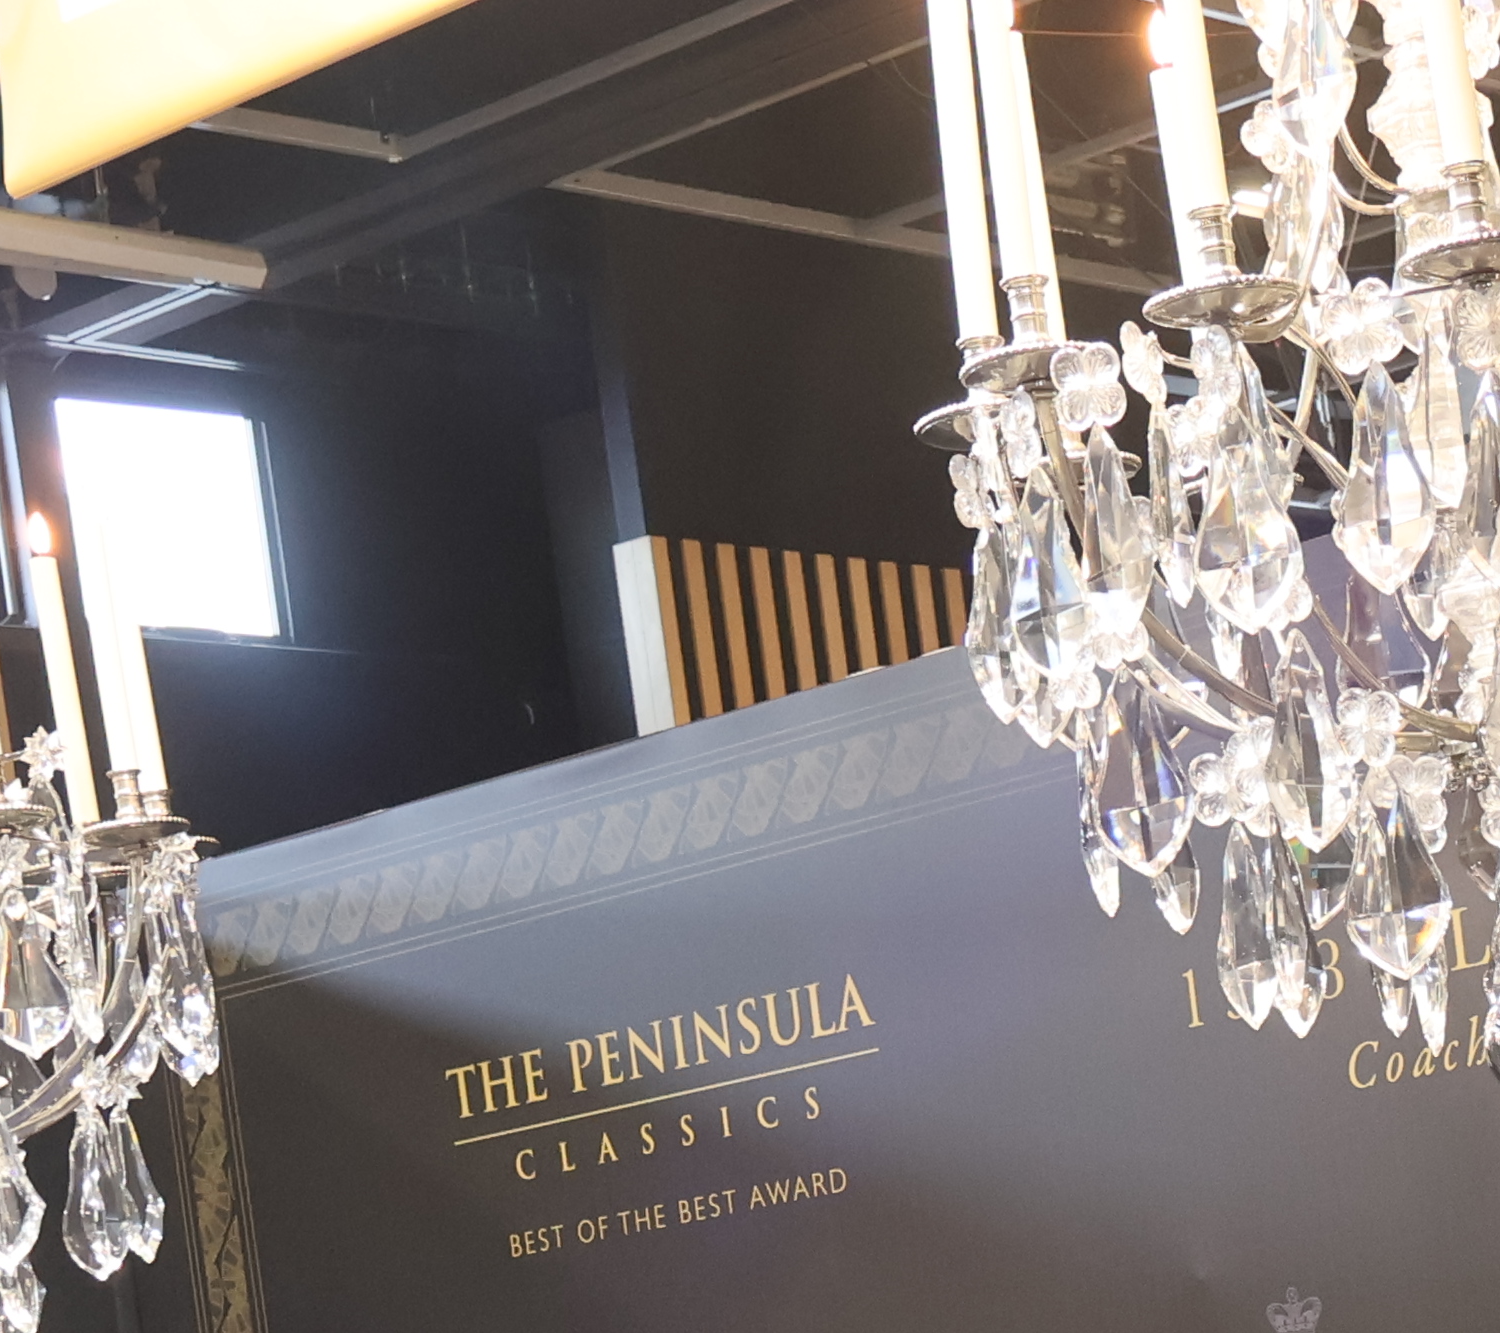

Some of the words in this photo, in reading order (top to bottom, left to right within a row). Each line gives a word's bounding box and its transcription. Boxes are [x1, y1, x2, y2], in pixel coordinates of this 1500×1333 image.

[444, 1048, 549, 1119] THE
[565, 973, 877, 1094] PENINSULA
[514, 1086, 822, 1180] CLASSICS
[508, 1223, 564, 1258] BEST
[577, 1216, 608, 1245] OF
[617, 1205, 667, 1236] THE
[678, 1190, 738, 1224] BEST
[749, 1167, 848, 1209] AWARD
